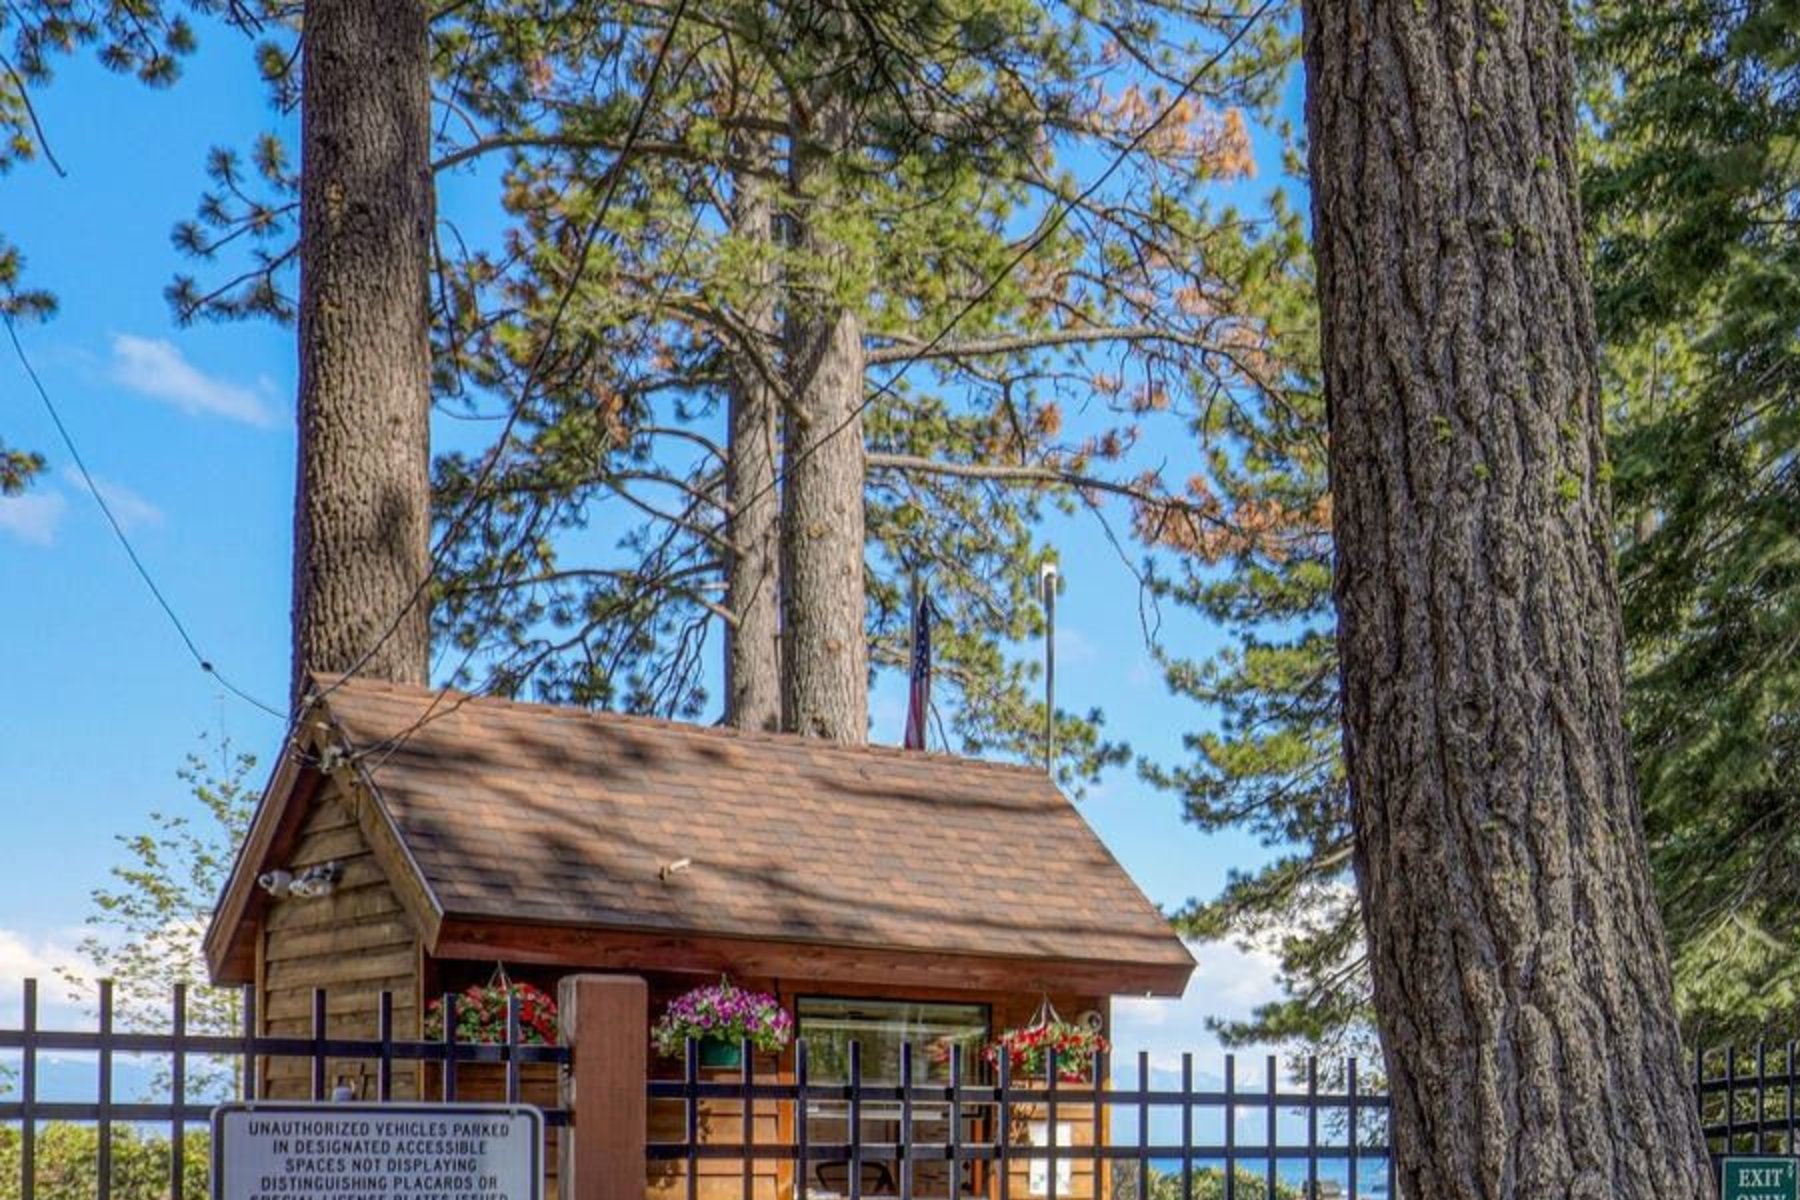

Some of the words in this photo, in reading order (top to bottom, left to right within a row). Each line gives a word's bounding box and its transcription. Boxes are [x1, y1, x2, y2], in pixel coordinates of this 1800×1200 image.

[249, 1121, 369, 1136] UNAUTHORIZED
[375, 1122, 447, 1137] VEHICLES
[453, 1123, 509, 1138] PARKED
[273, 1140, 289, 1154] IN
[295, 1140, 391, 1154] DESIGNATED
[396, 1140, 488, 1155] ACCESSIBLE
[285, 1158, 346, 1173] SPACES
[351, 1158, 381, 1172] NOT
[387, 1158, 477, 1173] DISPLAYING
[261, 1176, 387, 1191] DISTINGUISHING
[393, 1176, 473, 1191] PLACARDS
[478, 1176, 498, 1190] OR
[1738, 1168, 1785, 1188] EXIT
